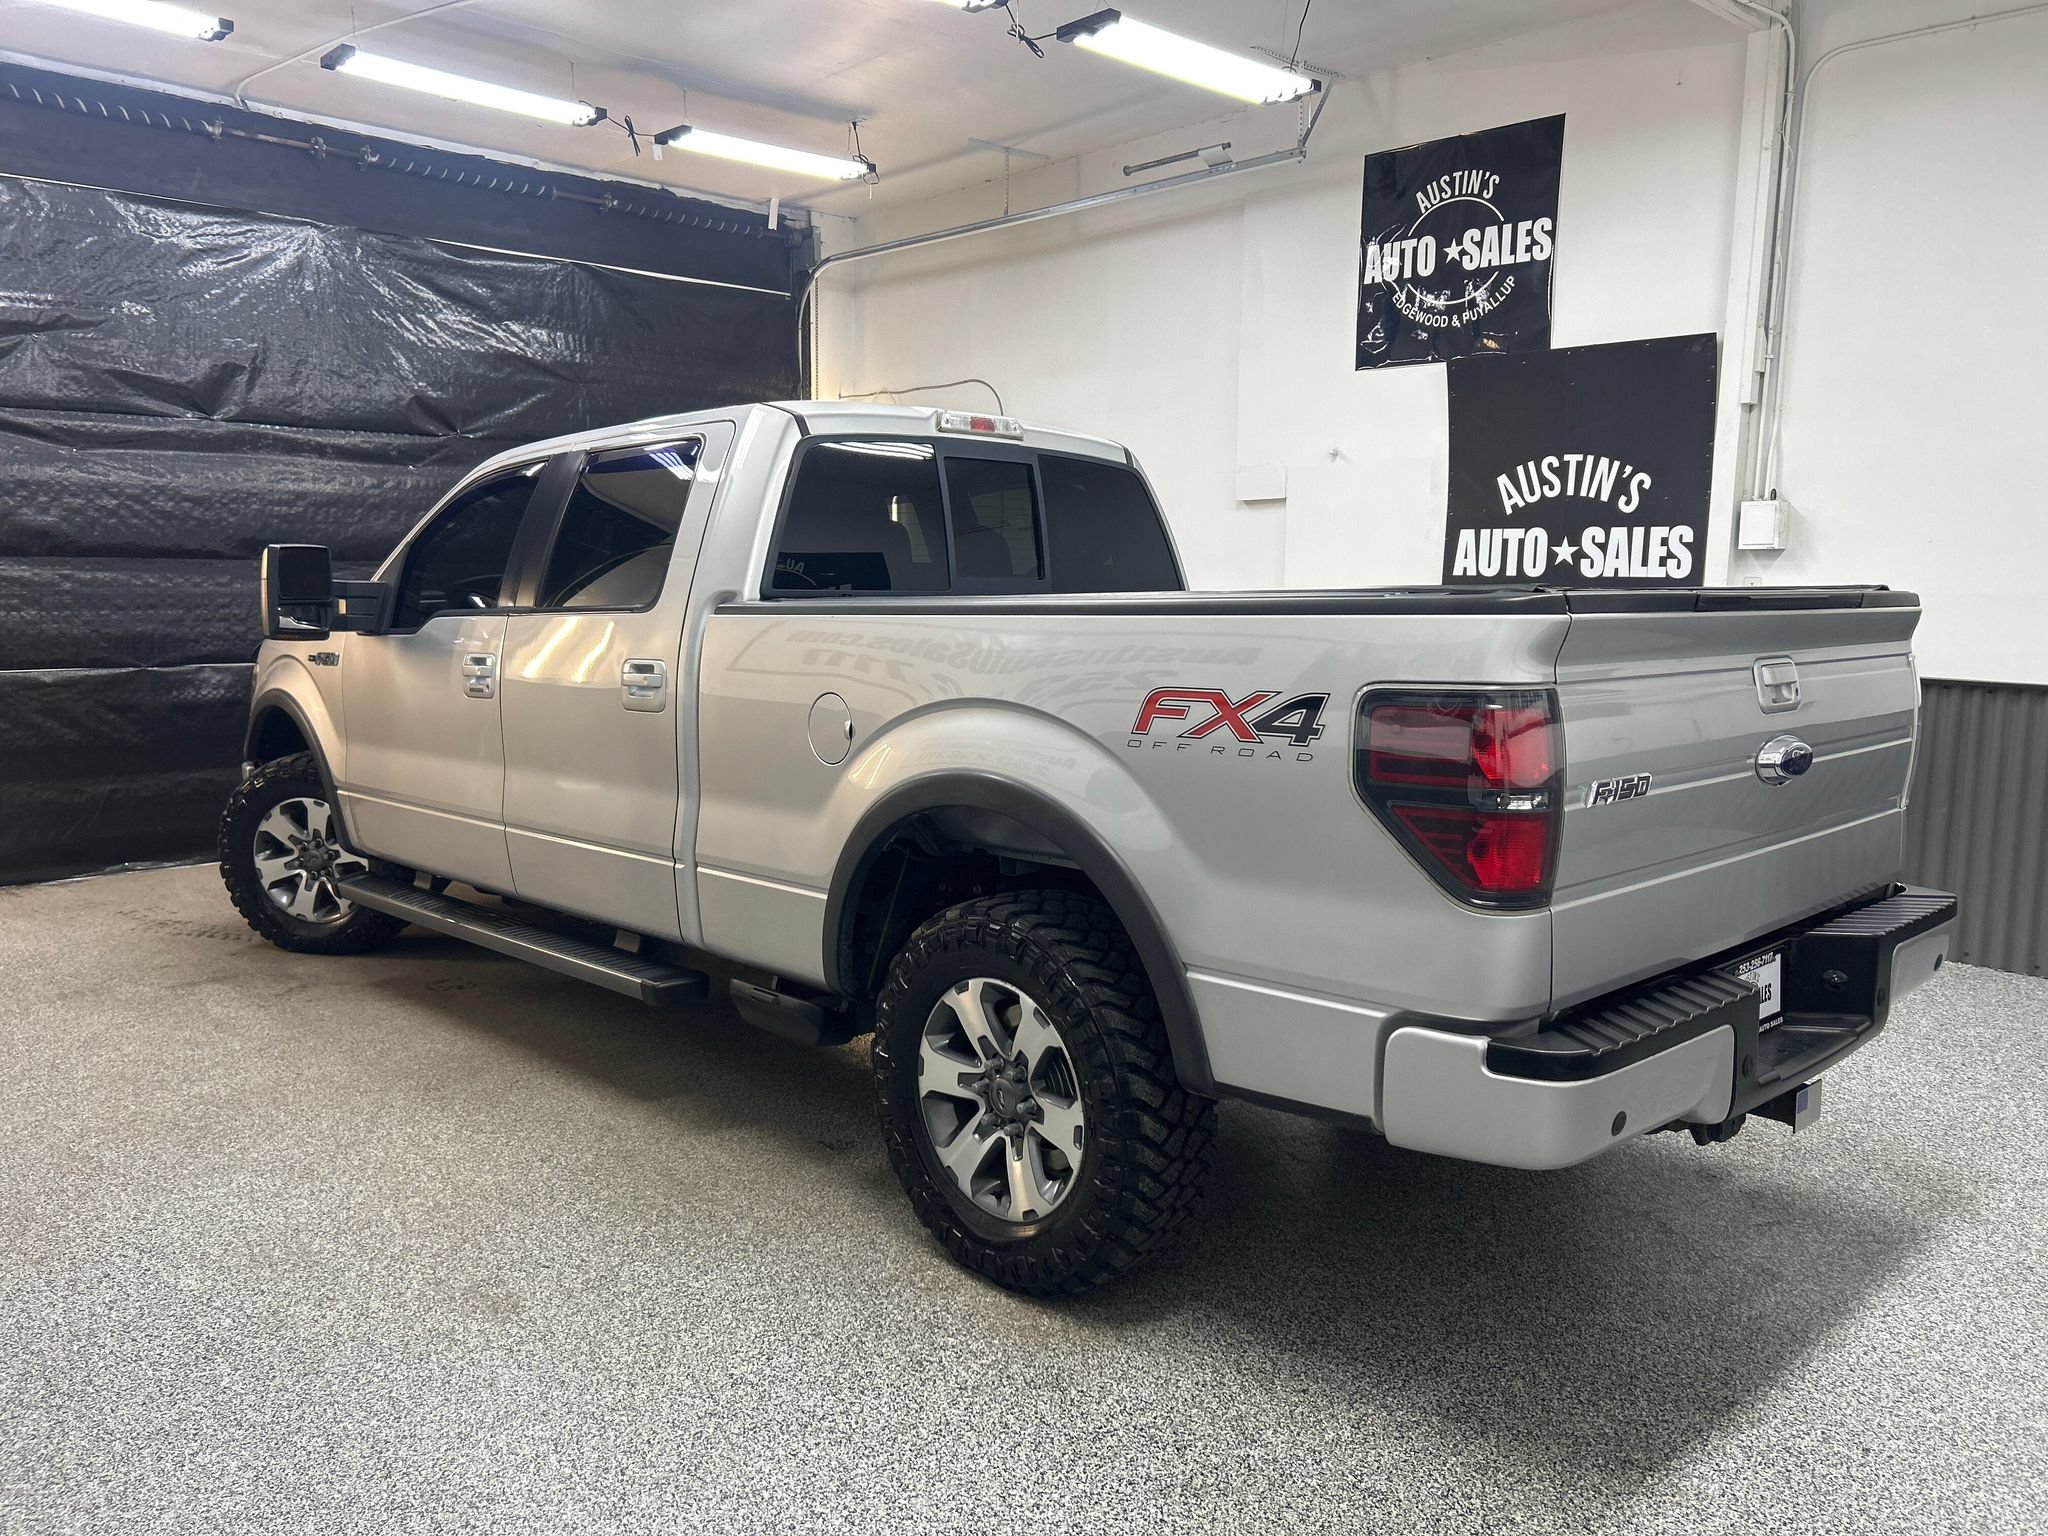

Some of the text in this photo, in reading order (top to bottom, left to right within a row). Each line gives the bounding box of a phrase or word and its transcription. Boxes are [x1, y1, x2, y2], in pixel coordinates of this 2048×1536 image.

[1416, 169, 1500, 213] AUSTIN'S
[1363, 217, 1553, 284] AUTO SALES
[1392, 275, 1516, 328] EDGEWOOD & PUYALLUP
[1496, 453, 1652, 516] AUSTIN'S
[1452, 525, 1694, 579] AUTO SALES
[1131, 686, 1331, 747] FX4
[1127, 739, 1314, 763] OFF ROAD
